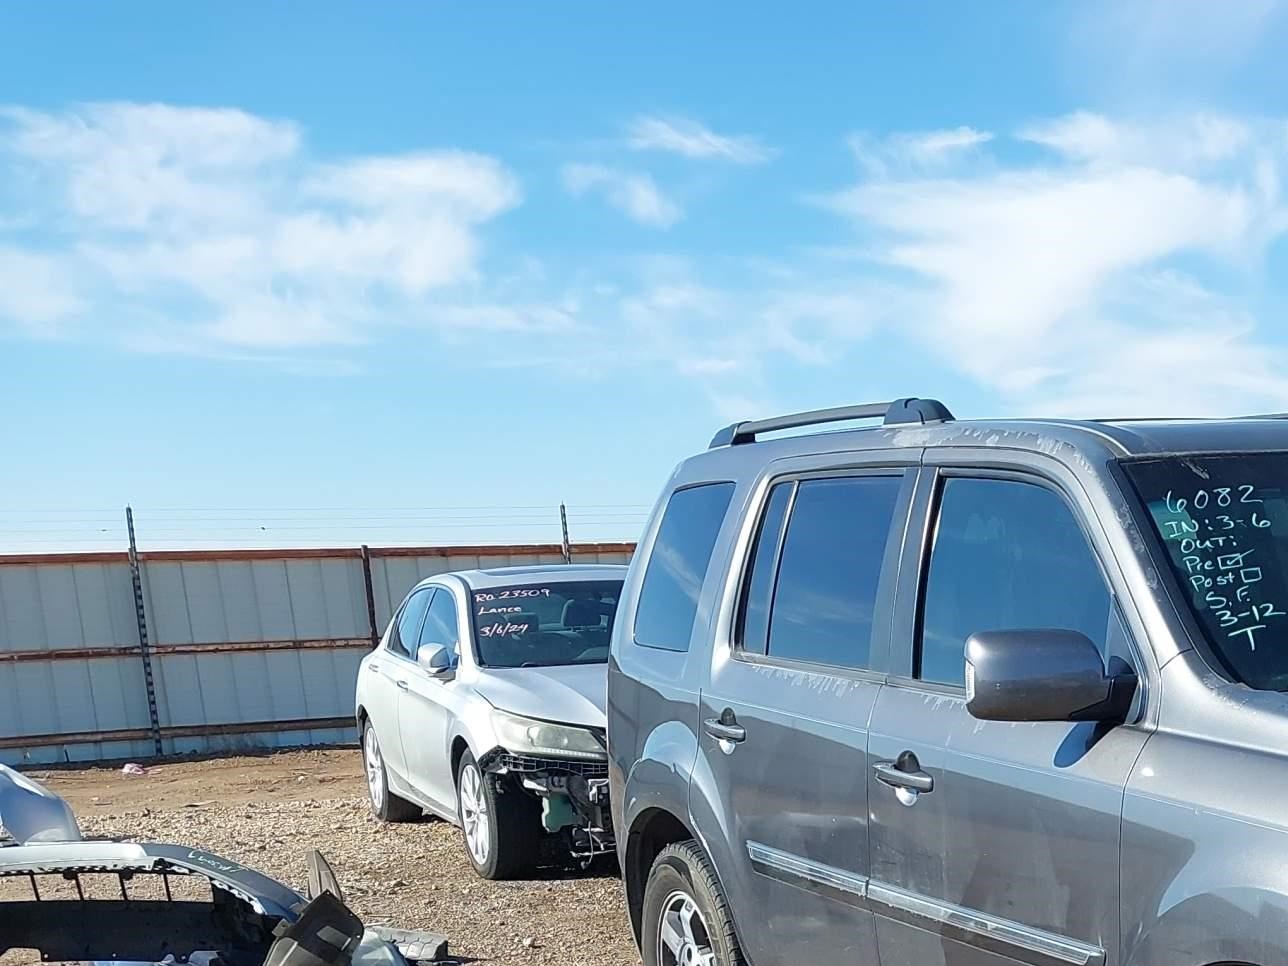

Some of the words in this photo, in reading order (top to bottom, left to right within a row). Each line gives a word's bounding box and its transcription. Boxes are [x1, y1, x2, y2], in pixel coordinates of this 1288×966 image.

[1165, 484, 1263, 514] 6082
[1182, 556, 1215, 573] Pre
[1189, 571, 1235, 592] Post
[1215, 603, 1287, 627] 3-12
